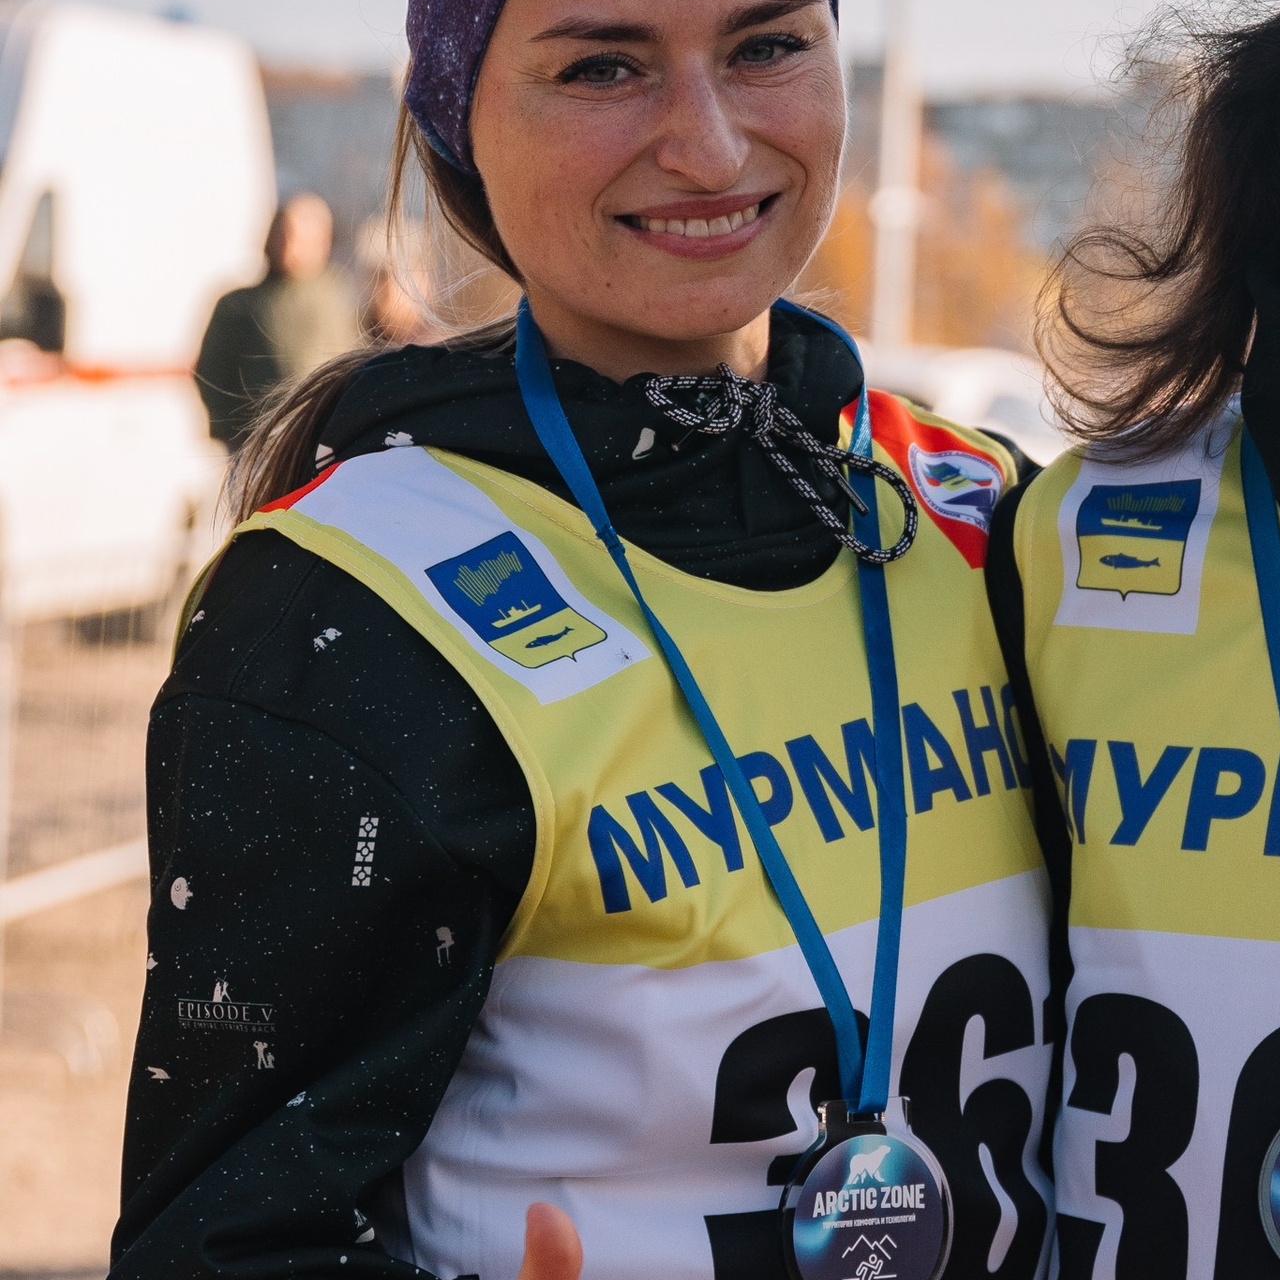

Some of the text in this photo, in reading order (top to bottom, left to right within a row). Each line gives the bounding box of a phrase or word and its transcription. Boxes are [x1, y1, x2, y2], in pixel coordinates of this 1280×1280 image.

[178, 1001, 273, 1022] EPISODE V
[812, 1183, 926, 1218] ARCTIC ZONE
